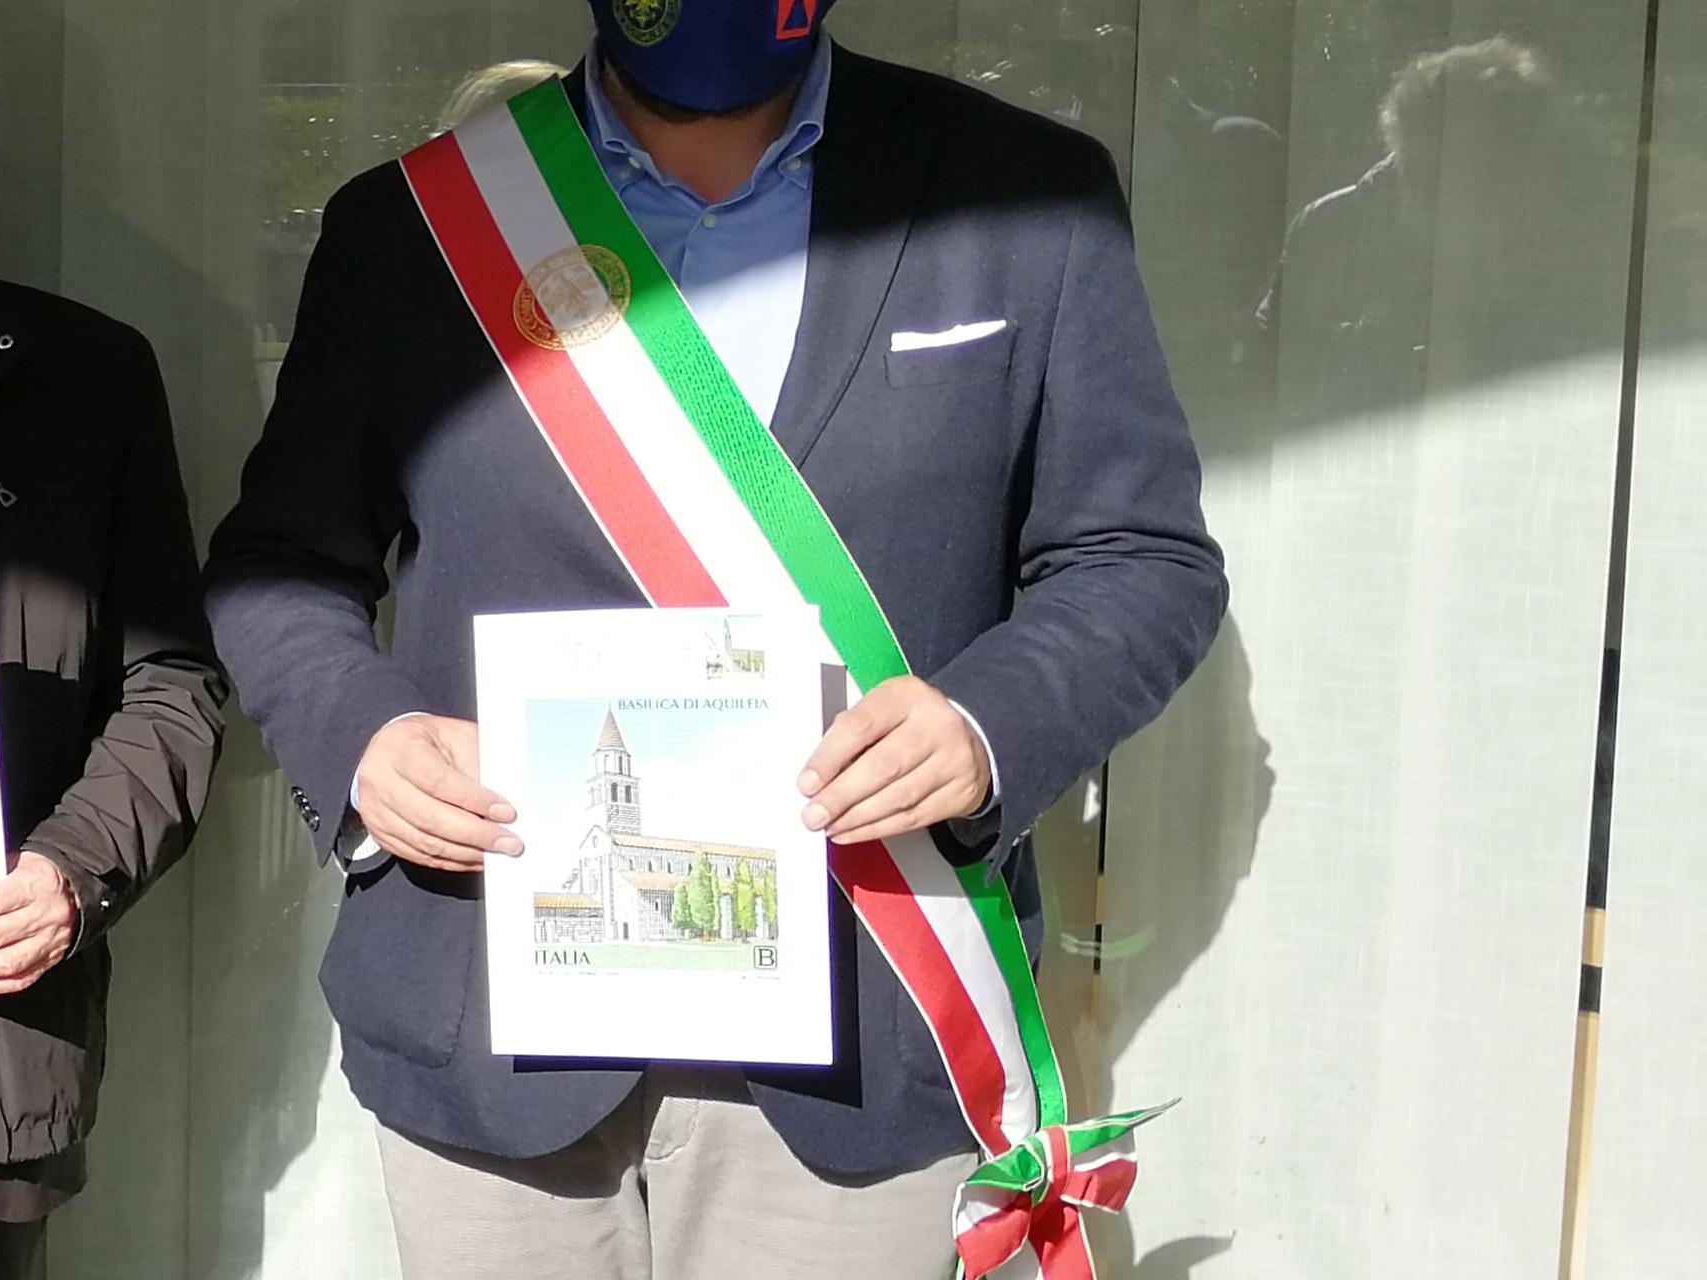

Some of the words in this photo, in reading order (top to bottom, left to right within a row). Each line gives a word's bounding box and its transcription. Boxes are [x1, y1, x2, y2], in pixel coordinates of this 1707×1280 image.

[617, 698, 679, 711] BASILICA
[684, 698, 699, 710] DI
[702, 698, 769, 713] AQUILEIA
[534, 950, 591, 966] ITALIA
[757, 949, 775, 966] B
